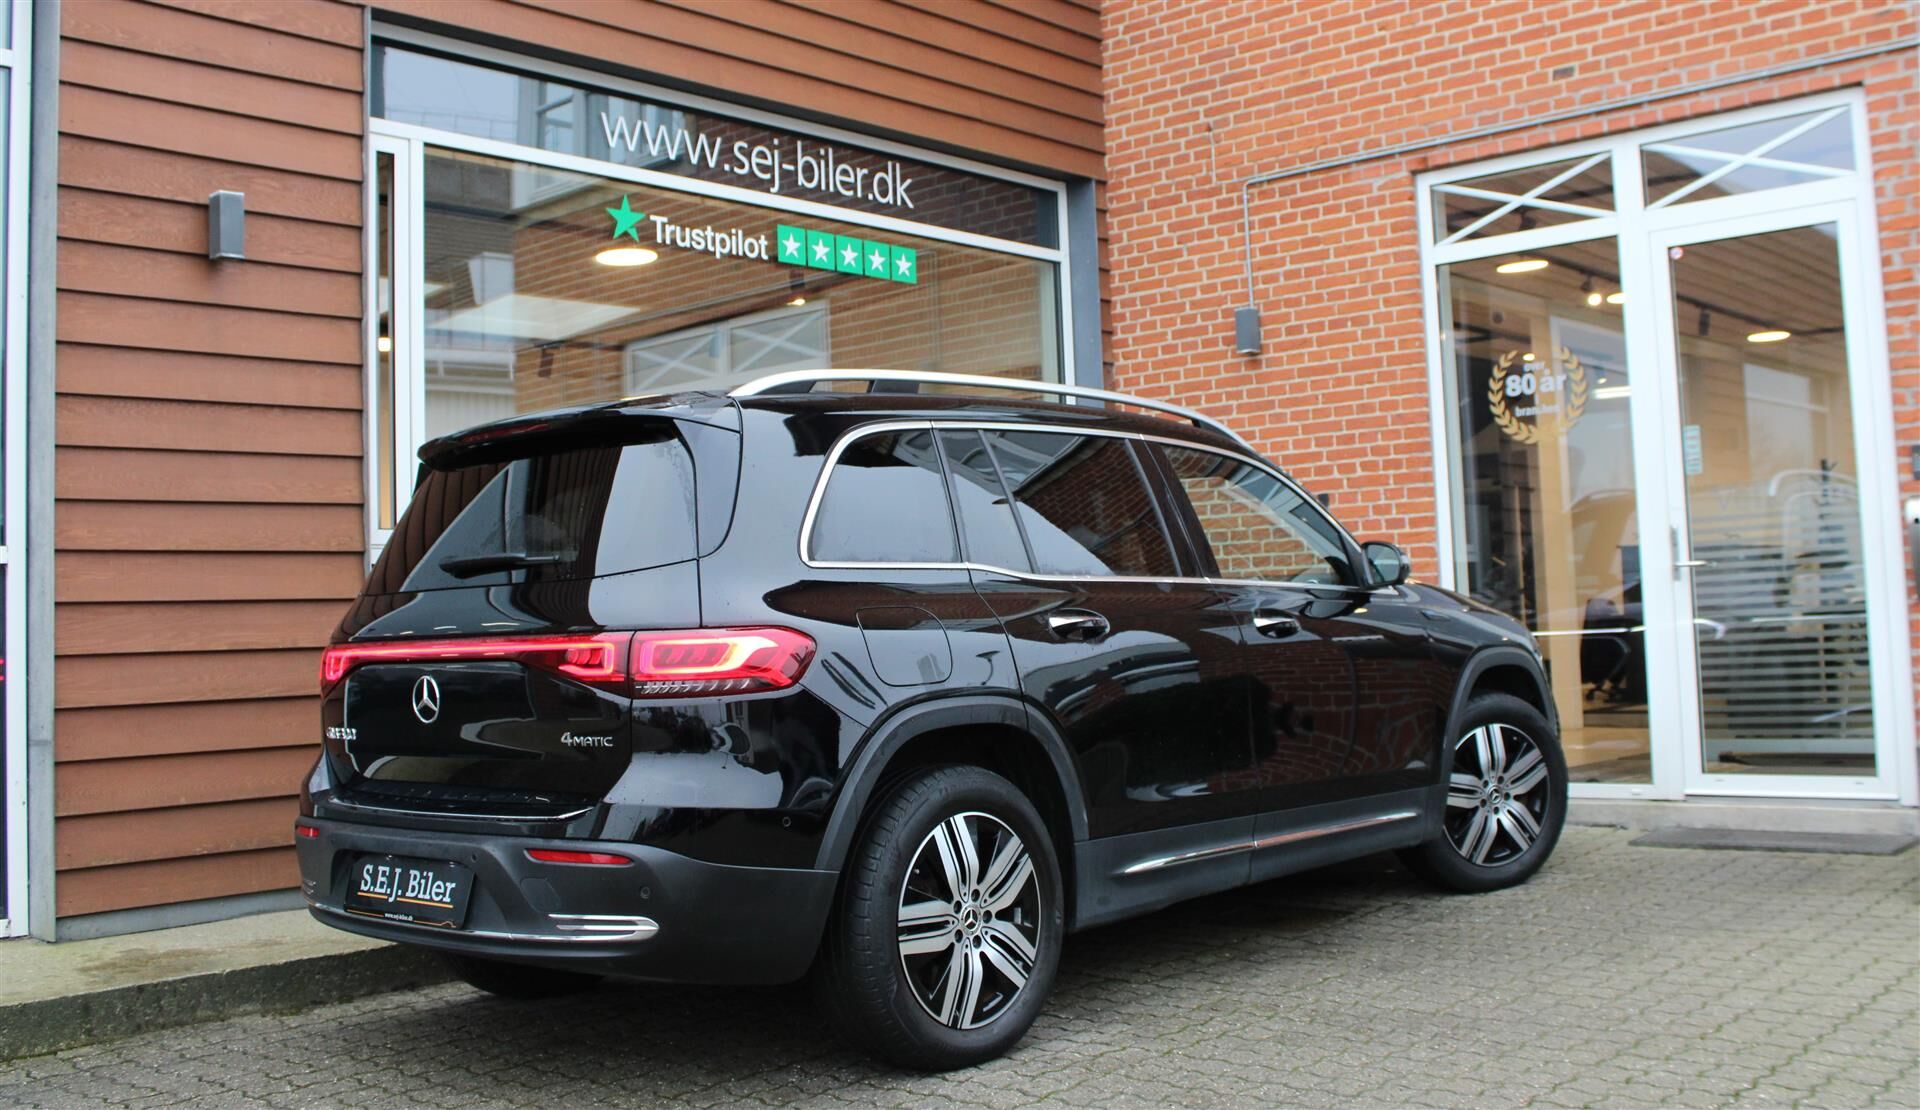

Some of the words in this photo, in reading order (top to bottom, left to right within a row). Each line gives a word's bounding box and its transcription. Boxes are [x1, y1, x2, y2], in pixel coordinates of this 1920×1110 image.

[601, 111, 914, 209] www.sej-biler.dk
[650, 215, 768, 261] Trustpilot
[1505, 373, 1536, 397] 80
[1540, 367, 1567, 392] år
[560, 731, 614, 747] 4MATIC
[360, 863, 402, 903] S.E.J.
[405, 869, 456, 903] Biler
